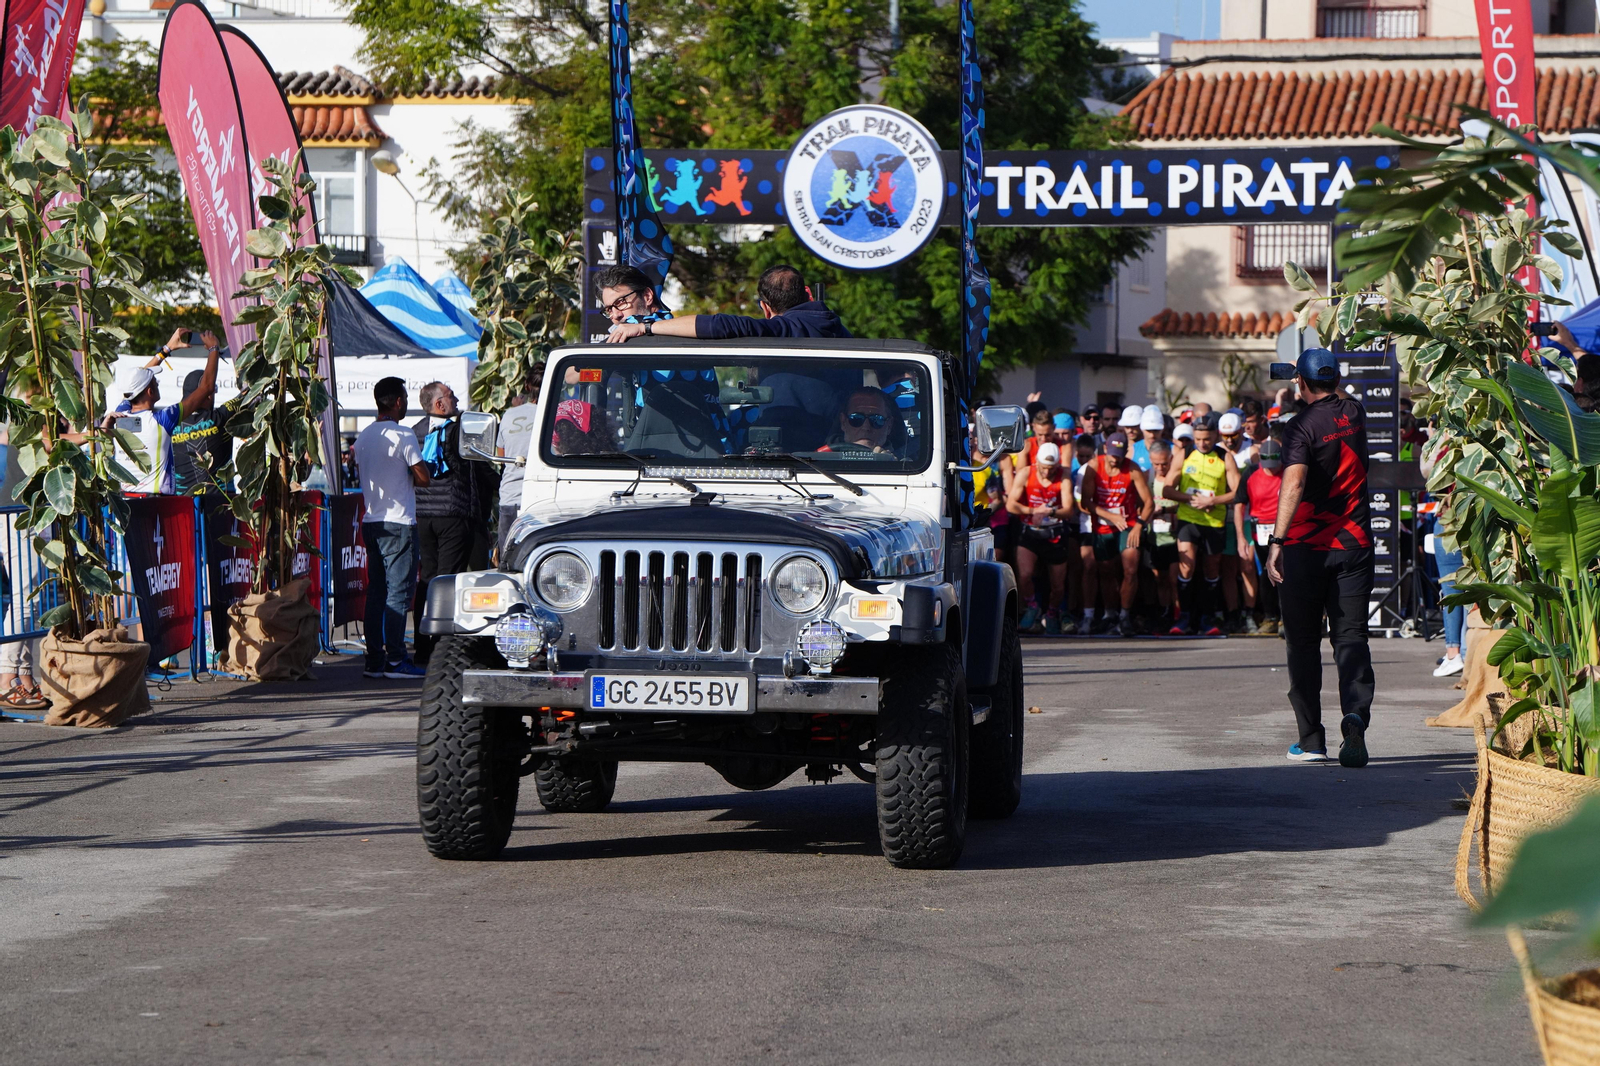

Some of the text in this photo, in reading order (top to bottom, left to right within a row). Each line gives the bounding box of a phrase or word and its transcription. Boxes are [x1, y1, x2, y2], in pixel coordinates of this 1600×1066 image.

[799, 116, 932, 173] TRAIL PIRATA
[985, 161, 1357, 210] TRAIL PIRATA
[909, 198, 934, 236] 2023
[811, 229, 832, 247] SAN
[832, 244, 896, 259] CRISTOBAL
[595, 694, 602, 702] E
[643, 681, 704, 705] 2455
[707, 681, 739, 706] BV
